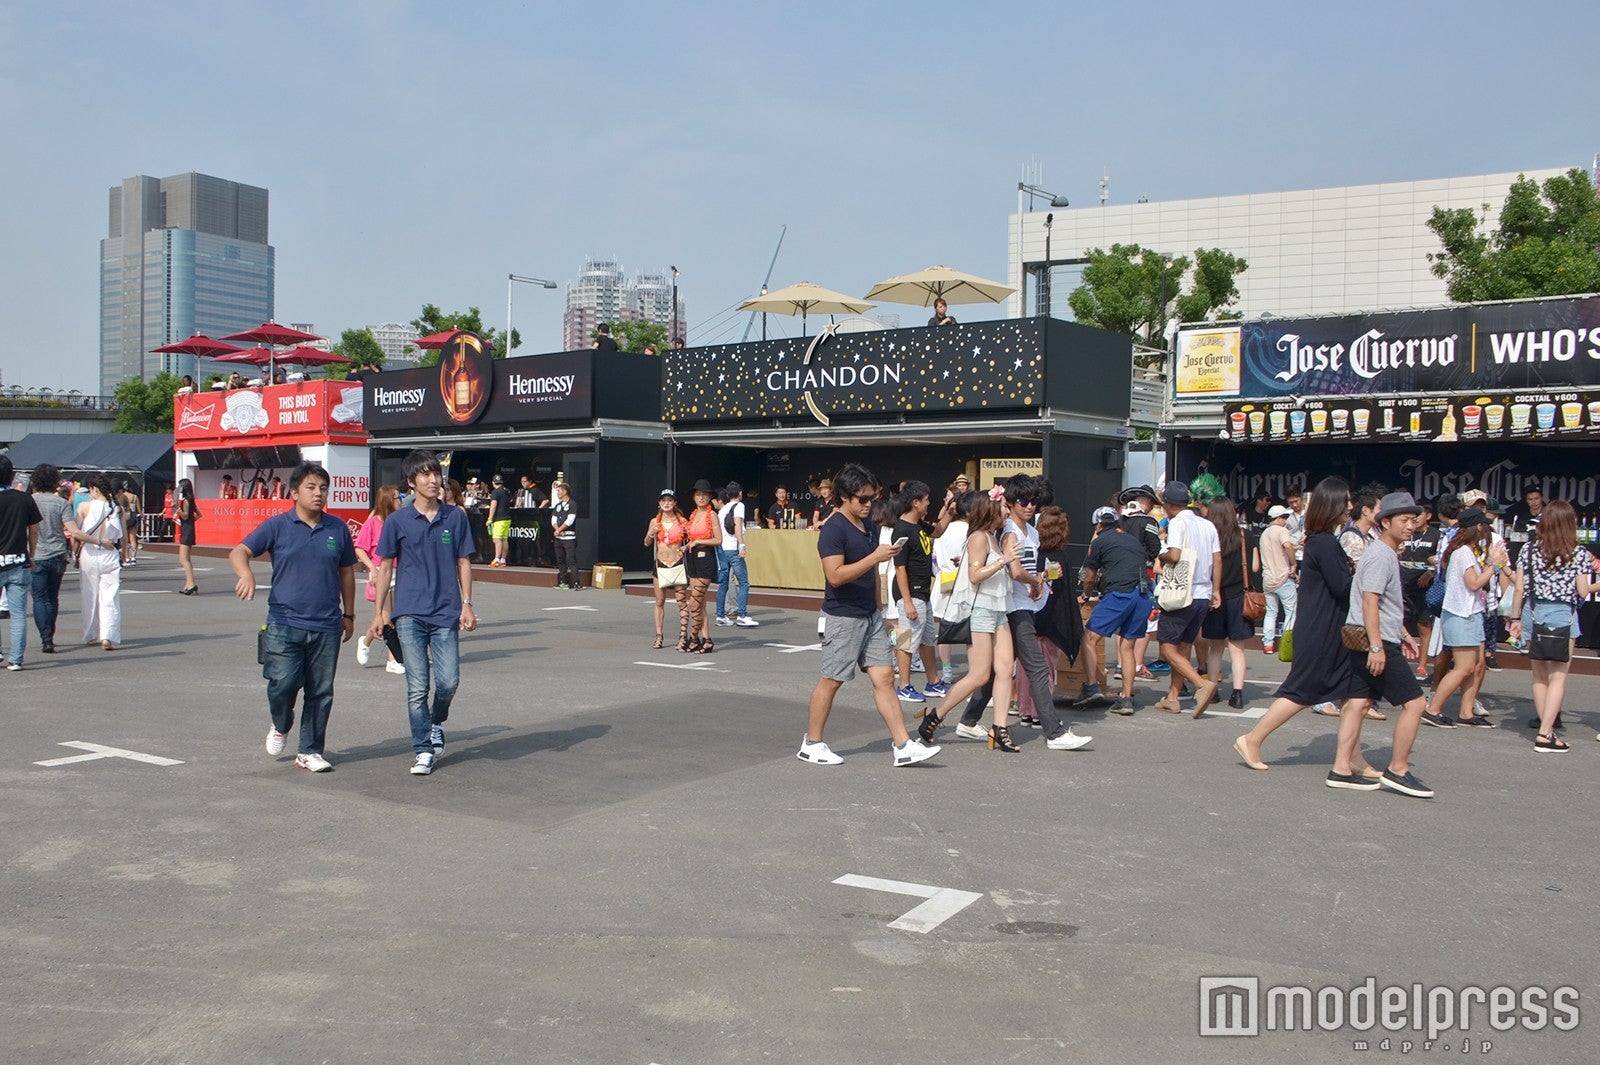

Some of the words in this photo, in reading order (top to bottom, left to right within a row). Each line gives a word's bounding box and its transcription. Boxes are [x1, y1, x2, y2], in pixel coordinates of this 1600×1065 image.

[1184, 354, 1204, 369] Jose
[1205, 353, 1234, 367] Cuervo
[1274, 333, 1345, 382] Jose
[766, 363, 901, 391] CHANDON
[509, 374, 575, 396] Hennessy
[278, 396, 294, 410] THIS
[295, 394, 316, 407] BUD'S
[374, 387, 426, 407] Hennessy
[1378, 399, 1396, 407] SHOT
[1515, 394, 1551, 403] COCKTAIL
[1273, 402, 1302, 410] COCKTA
[279, 411, 293, 424] FOR
[293, 410, 309, 424] YOU.
[983, 460, 1041, 469] CHANDON
[333, 476, 356, 488] THIS
[1400, 459, 1474, 500] Jose
[333, 490, 353, 503] FOR
[355, 490, 368, 503] YO
[214, 507, 235, 515] KING
[238, 507, 251, 516] OF
[253, 507, 283, 517] BEERS
[508, 526, 538, 541] nnessy
[0, 553, 26, 567] REW
